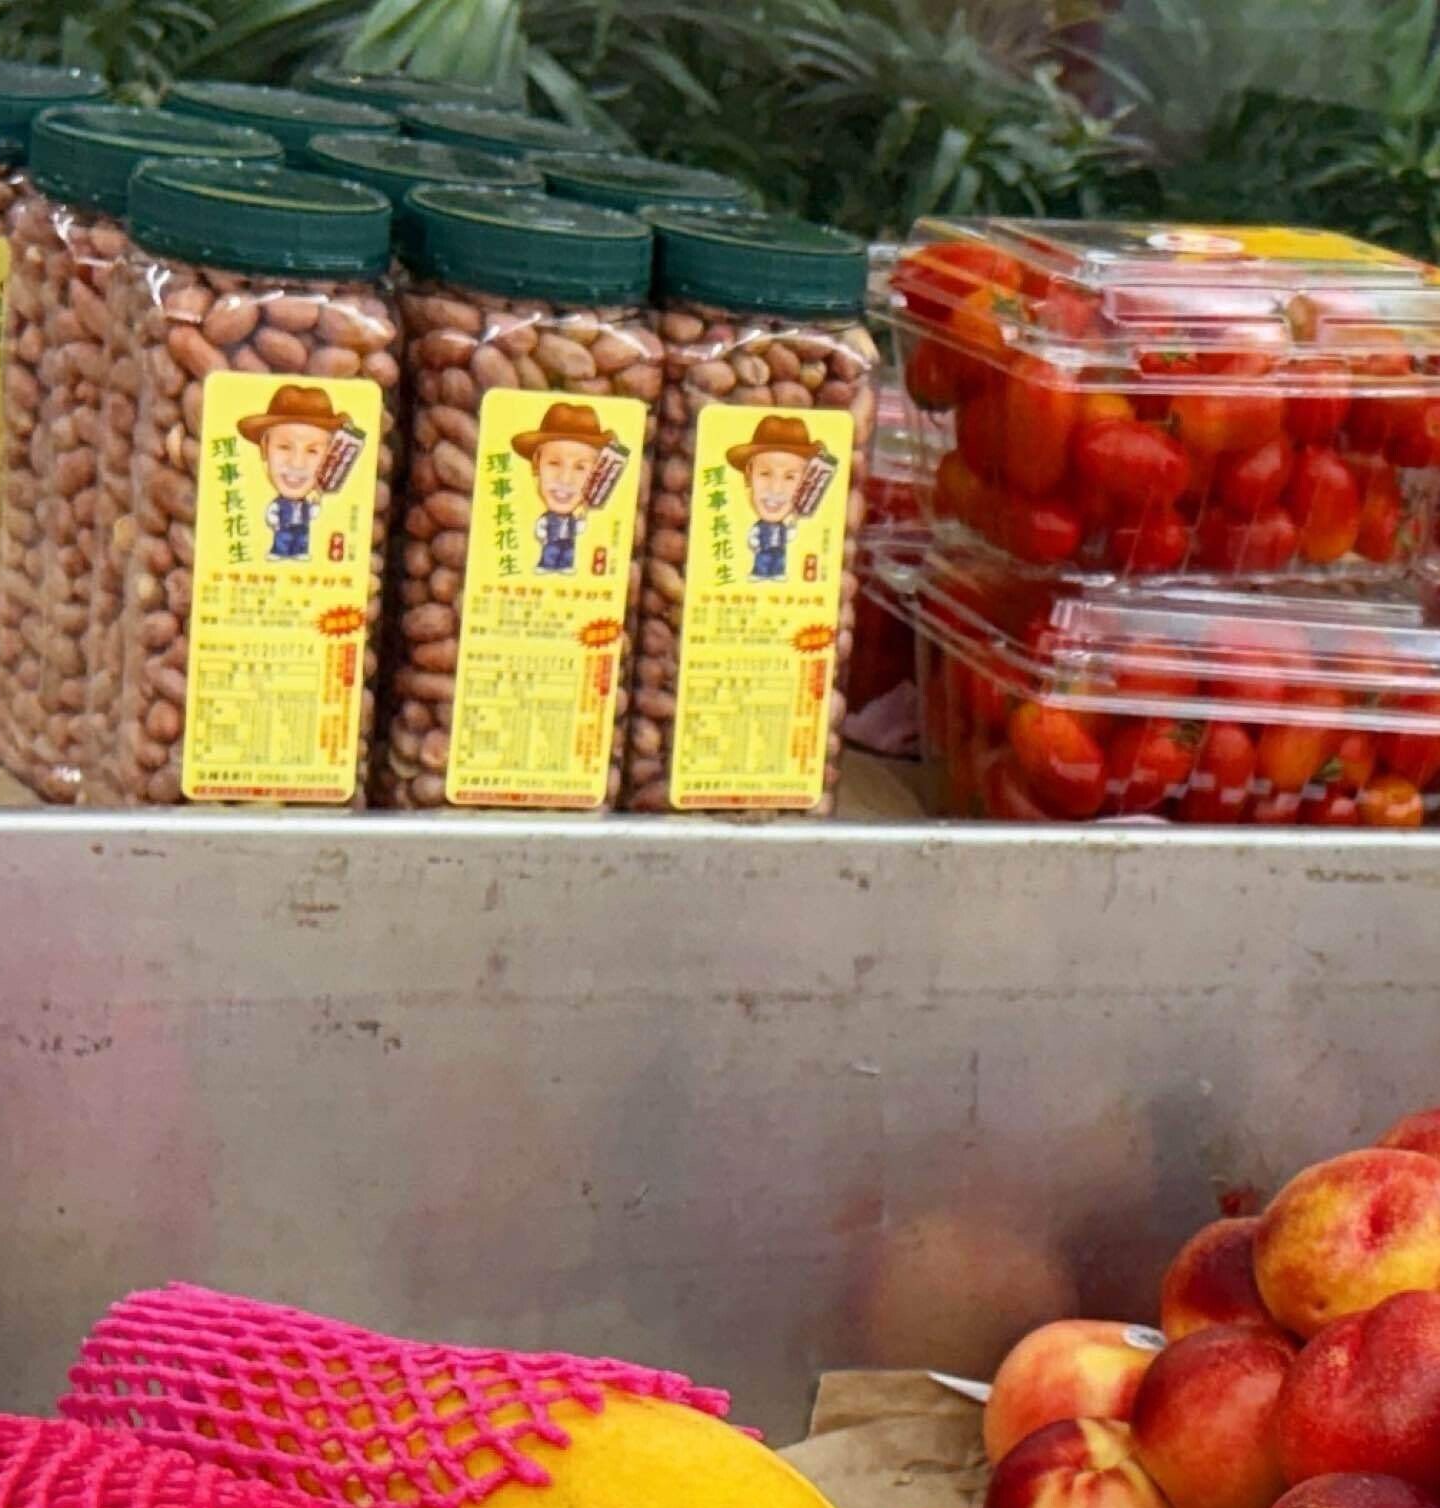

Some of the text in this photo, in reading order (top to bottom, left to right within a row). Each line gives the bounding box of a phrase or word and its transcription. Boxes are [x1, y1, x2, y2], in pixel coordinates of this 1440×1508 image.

[209, 435, 253, 565] 理事長花生
[485, 450, 522, 580] 理事長花生
[702, 464, 737, 587] 理事長花生
